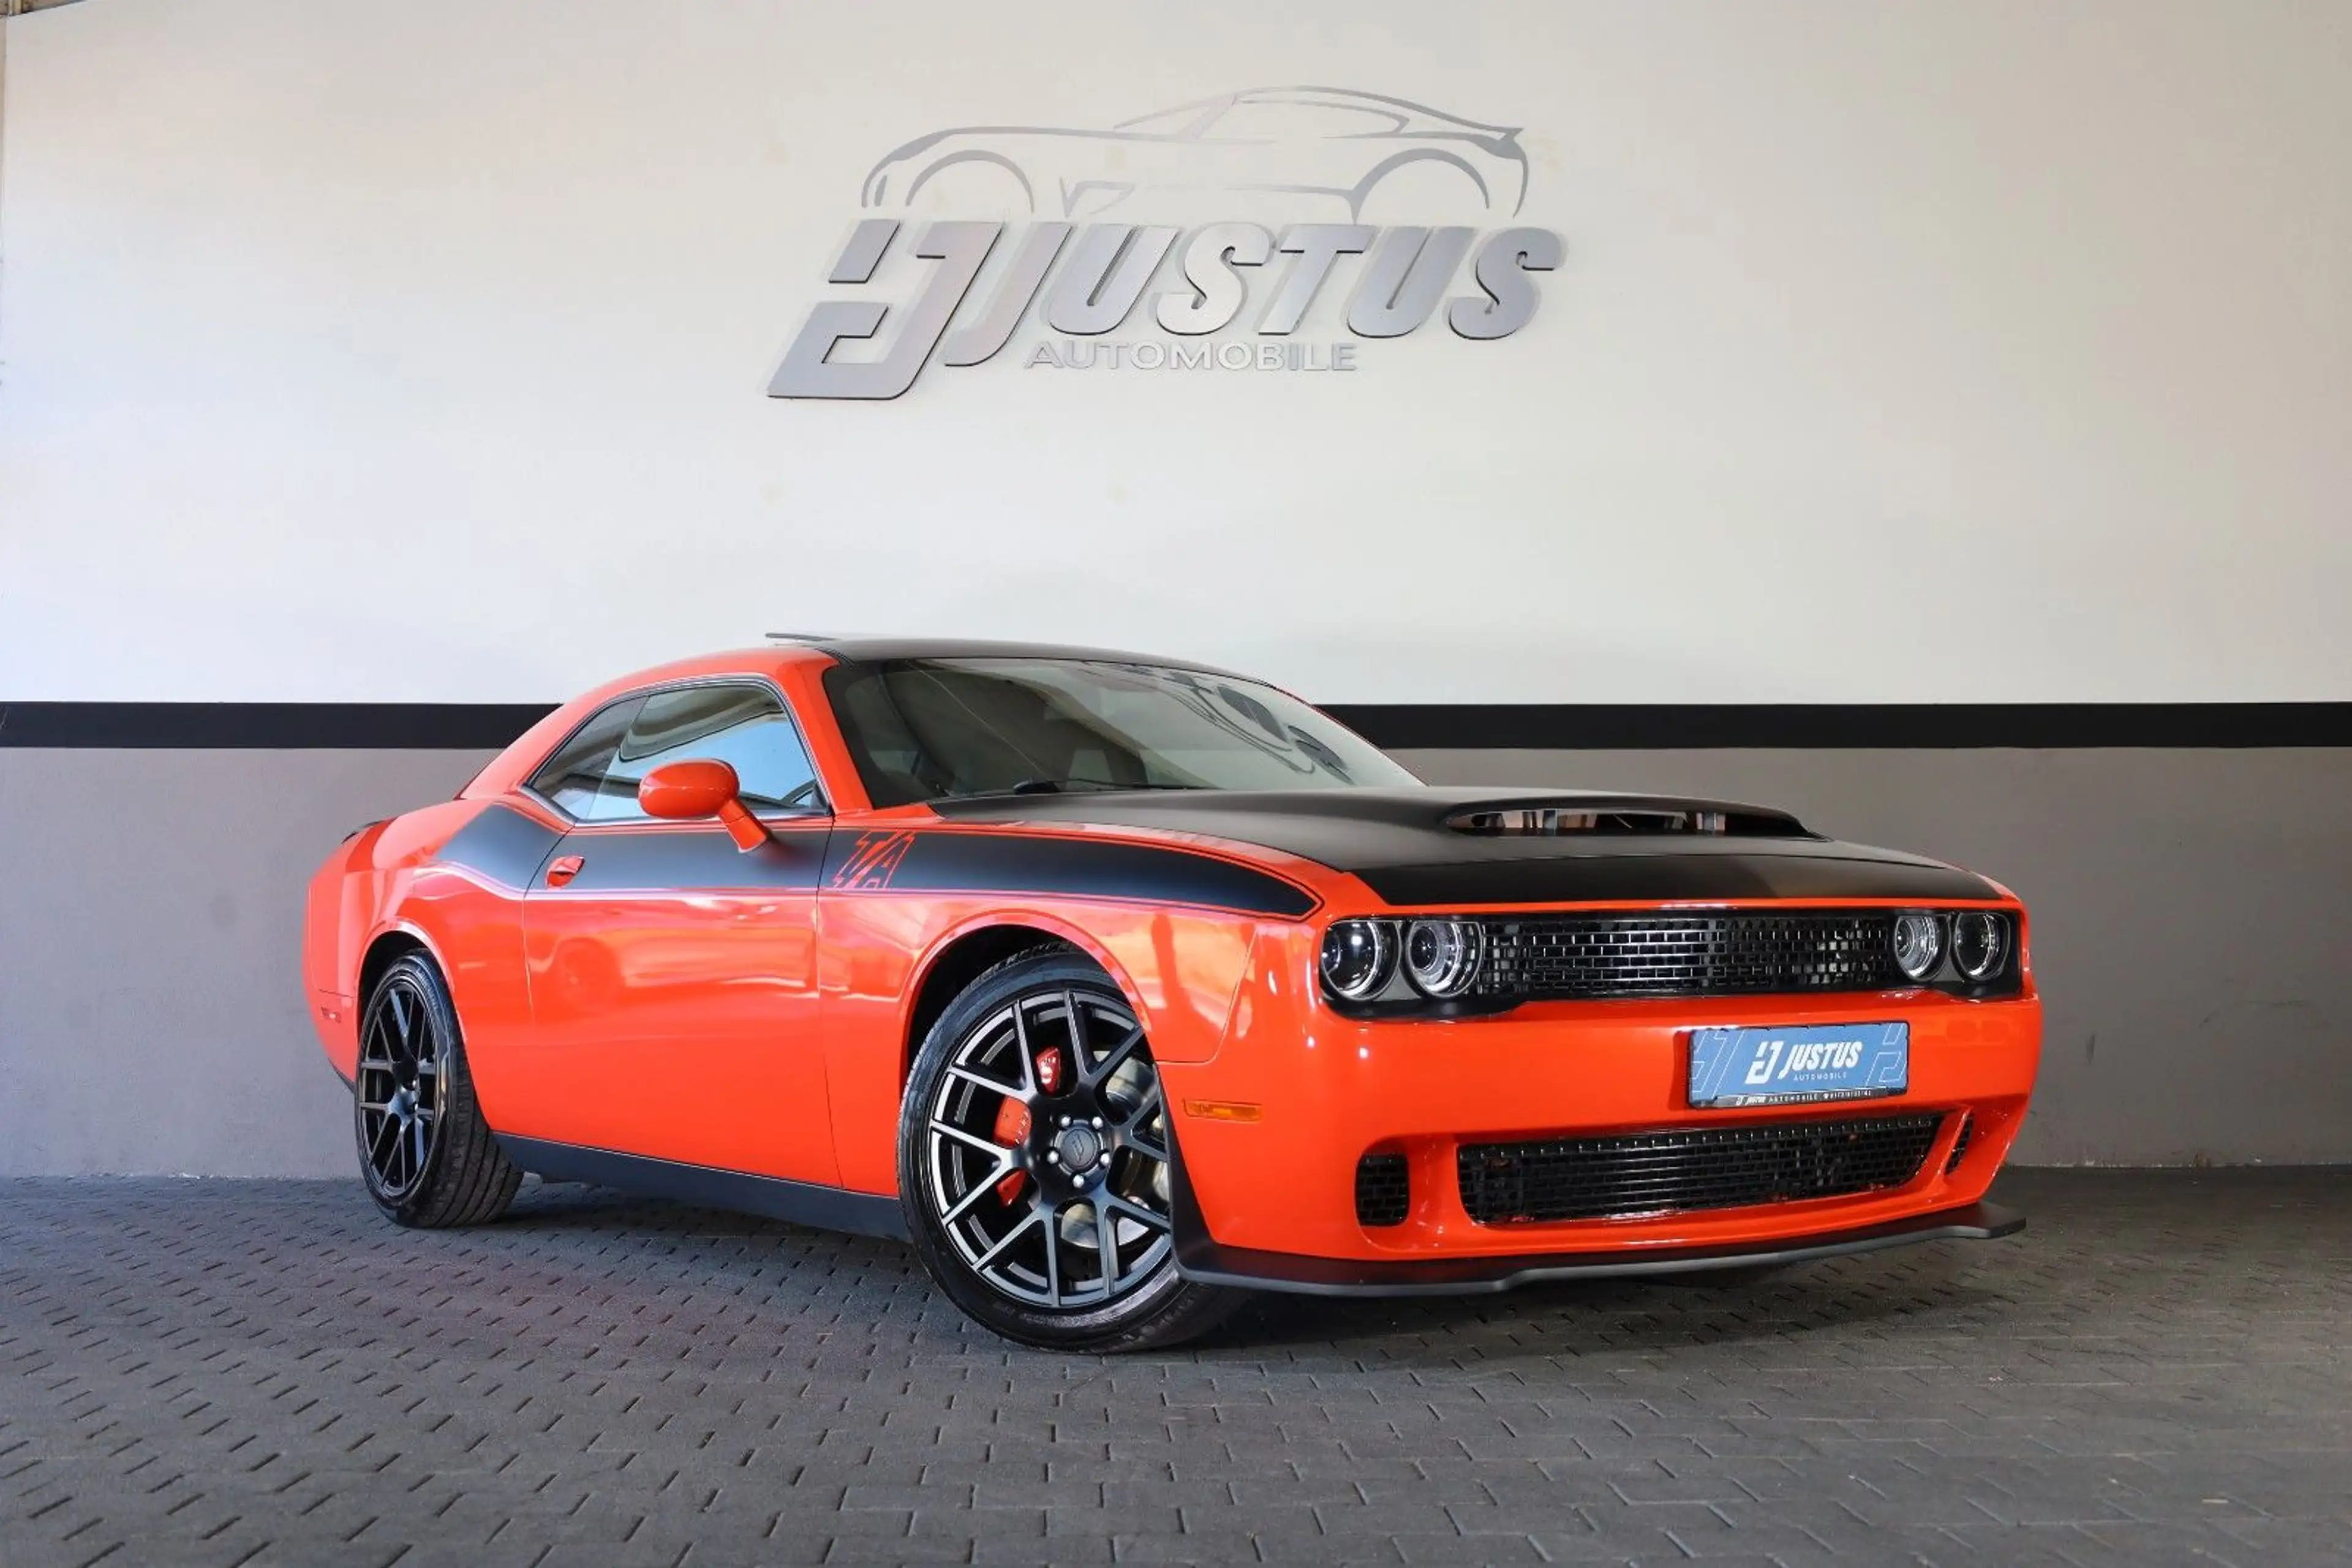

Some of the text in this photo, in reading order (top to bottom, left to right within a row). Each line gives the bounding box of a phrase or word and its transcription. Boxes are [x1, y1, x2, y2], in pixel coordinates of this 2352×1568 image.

[945, 222, 1559, 368] JUSTUS
[1027, 341, 1357, 371] AUTOMOBILE
[1777, 1041, 1863, 1079] JUSTUS
[1793, 1072, 1847, 1081] AUTOMOBILE
